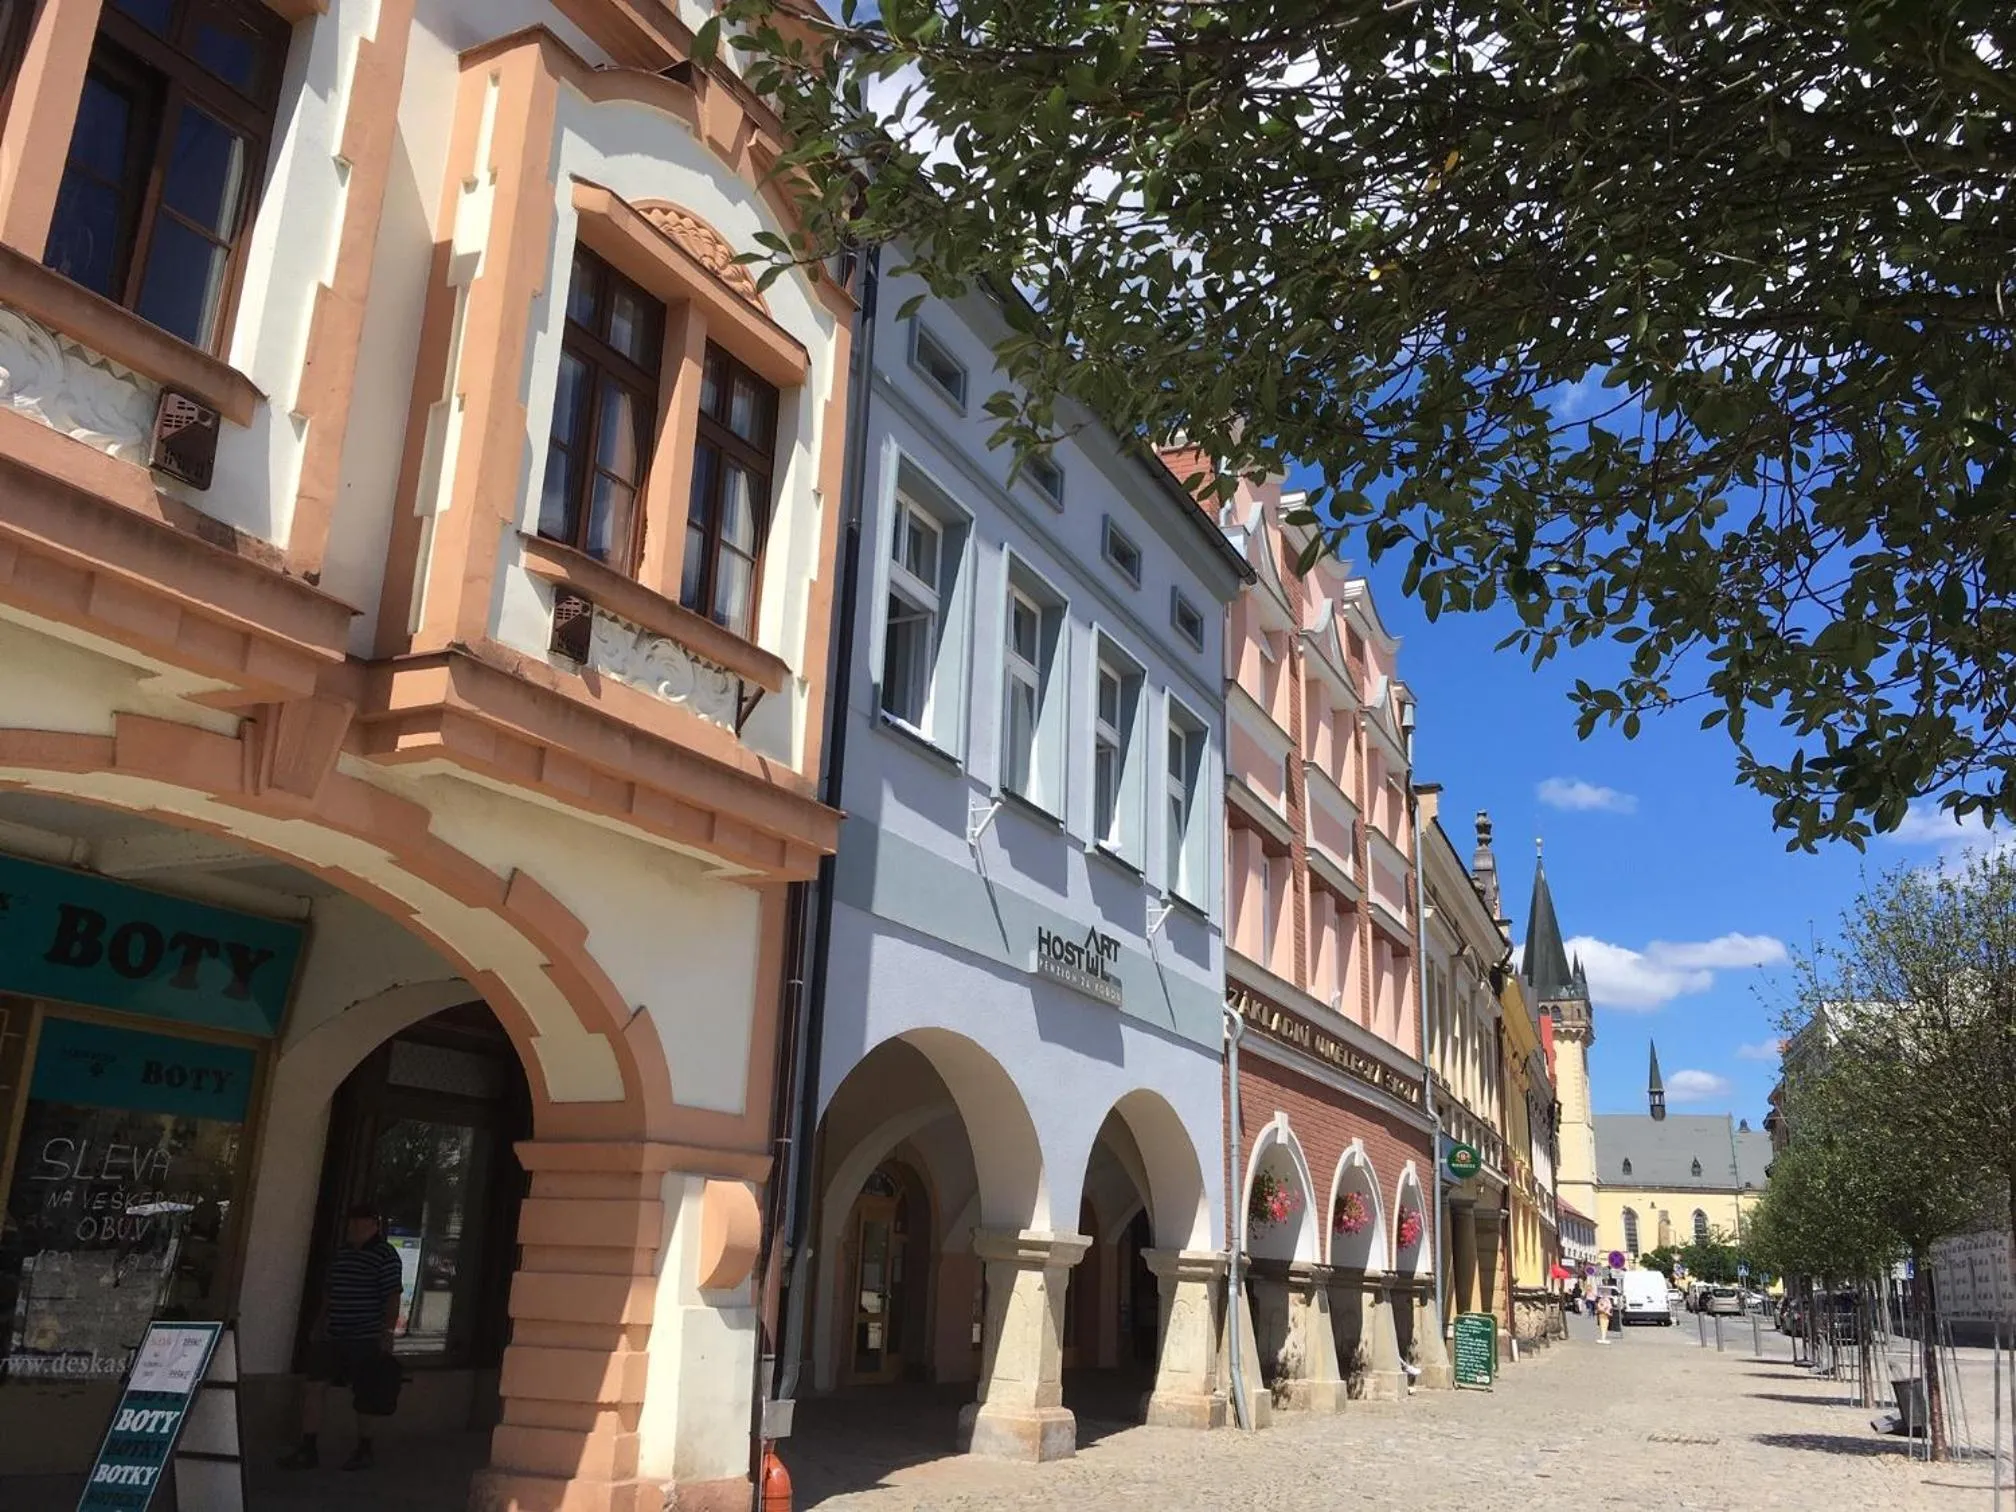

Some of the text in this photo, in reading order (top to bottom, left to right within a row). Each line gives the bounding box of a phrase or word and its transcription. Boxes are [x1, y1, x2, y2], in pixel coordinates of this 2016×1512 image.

[44, 903, 274, 998] BOTY
[141, 1060, 233, 1093] BOTY
[30, 1138, 172, 1181] SLEVA
[76, 1216, 150, 1241] OBUV
[114, 1409, 180, 1434] BOTY
[94, 1464, 158, 1486] BOTKY
